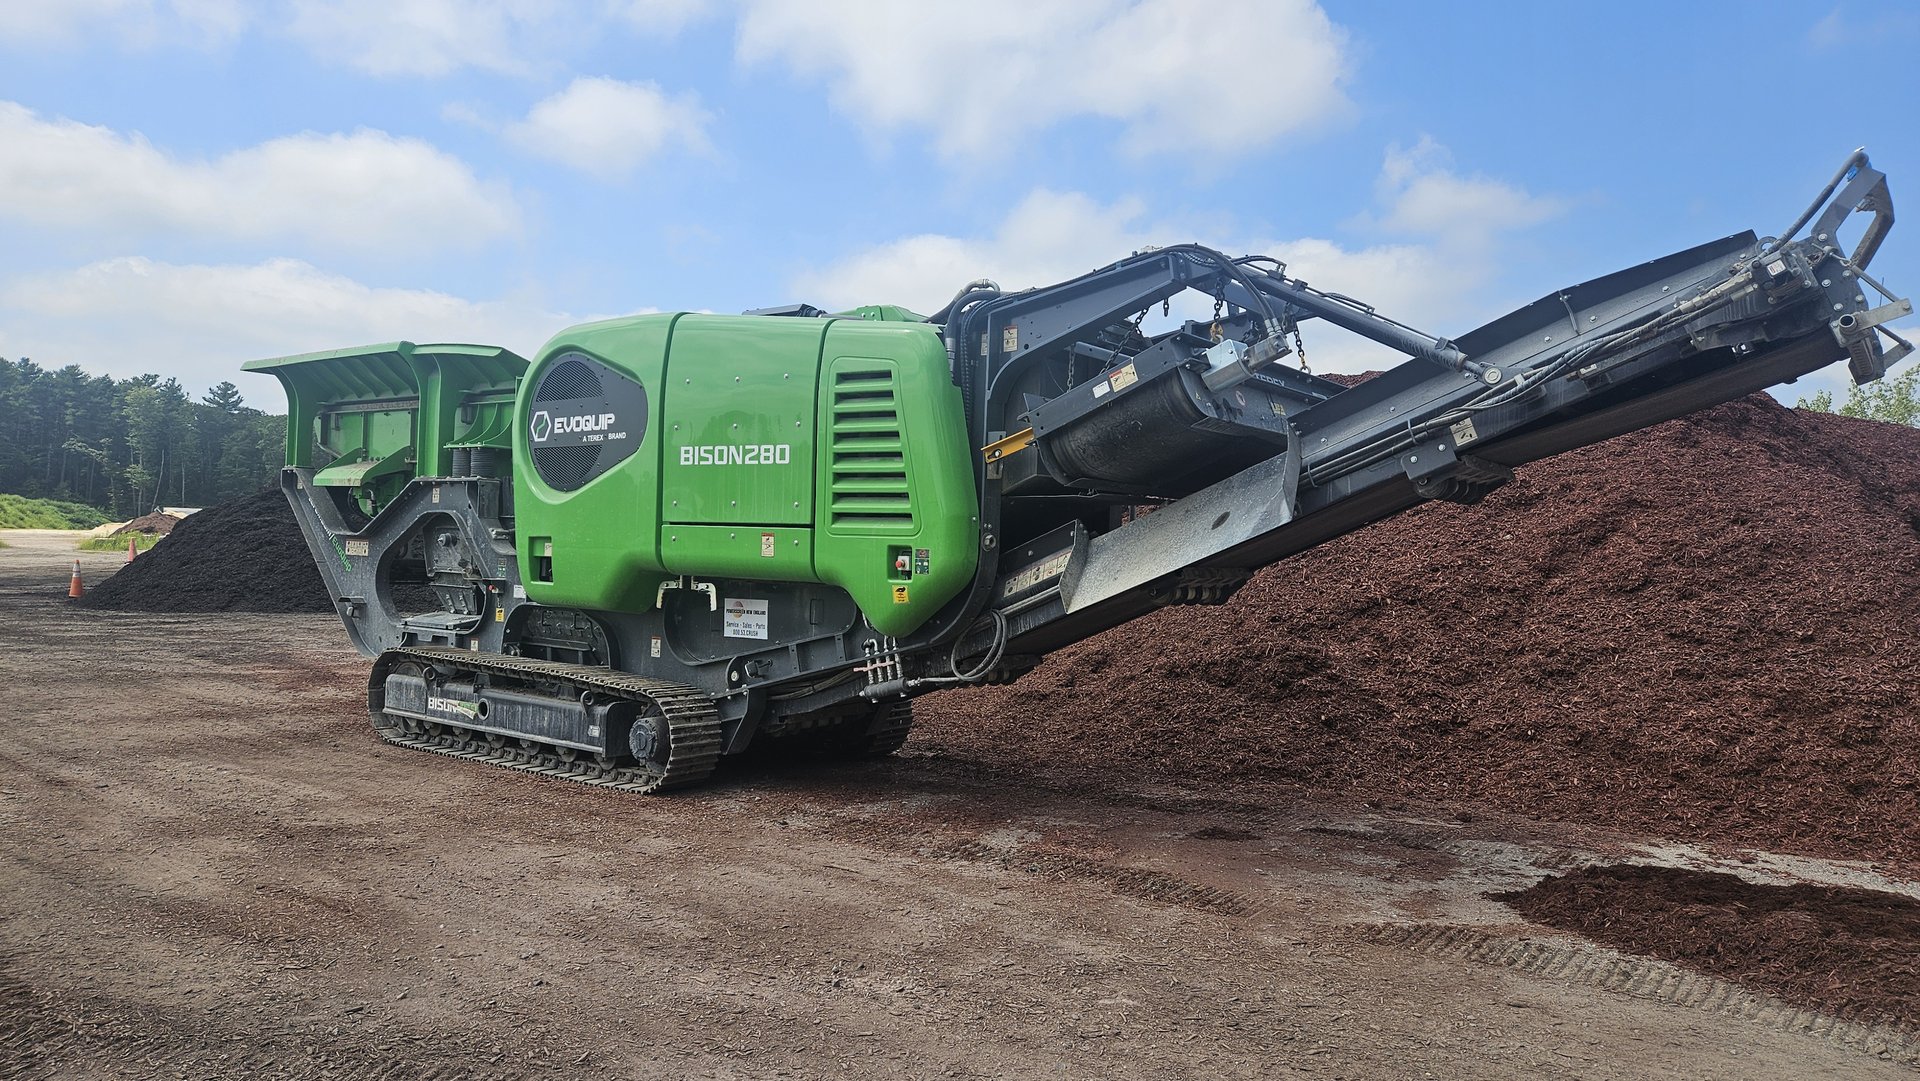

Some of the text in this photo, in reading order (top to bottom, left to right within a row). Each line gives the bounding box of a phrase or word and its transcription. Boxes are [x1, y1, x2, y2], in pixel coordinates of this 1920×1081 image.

[553, 413, 616, 434] EVOQUIP
[587, 433, 604, 442] TEREX
[607, 431, 627, 440] BRAND
[680, 444, 790, 465] BISON280
[726, 620, 766, 630] Service Sales Parts
